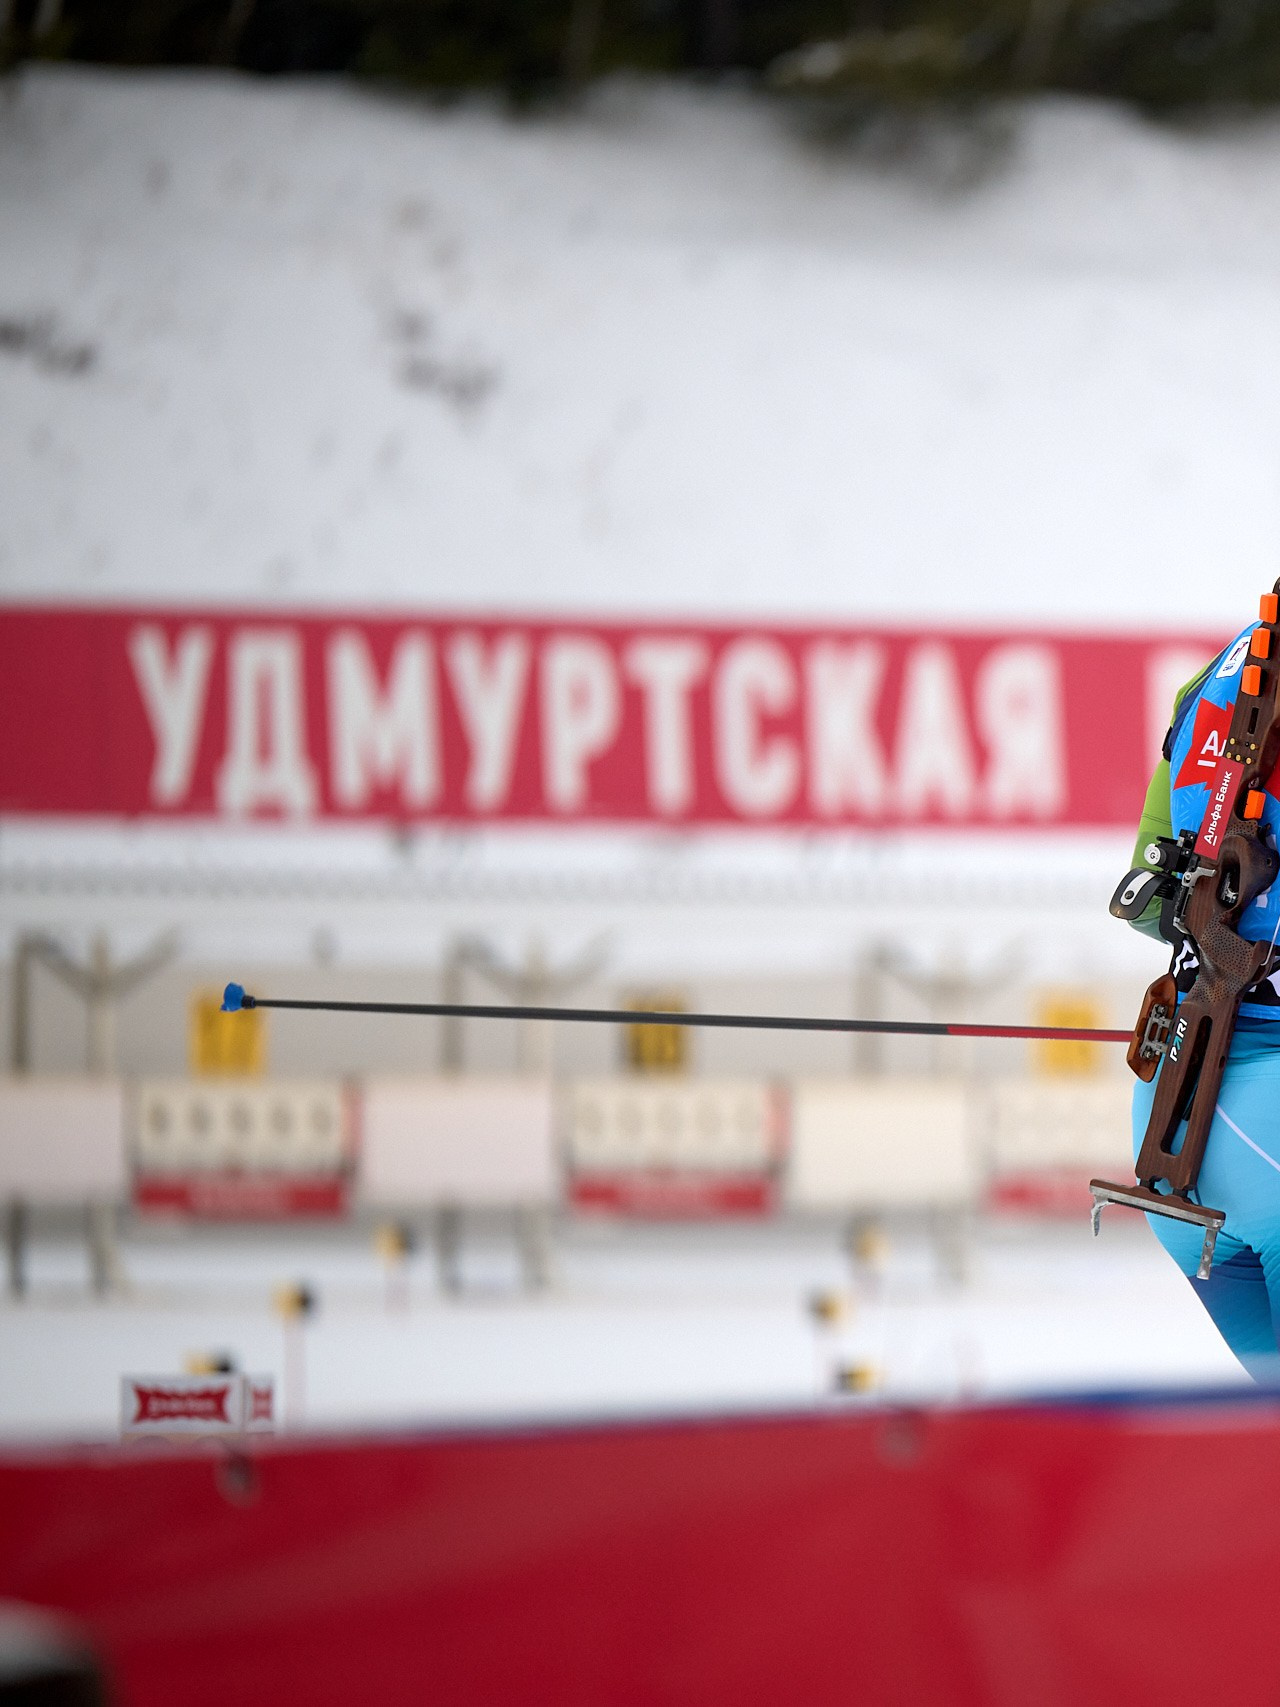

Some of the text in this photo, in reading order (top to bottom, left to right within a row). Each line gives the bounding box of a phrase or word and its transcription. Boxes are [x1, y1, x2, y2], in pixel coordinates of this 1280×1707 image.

[127, 622, 1066, 825] УДМУРТСКАЯ
[1203, 771, 1233, 846] Альфа Банк
